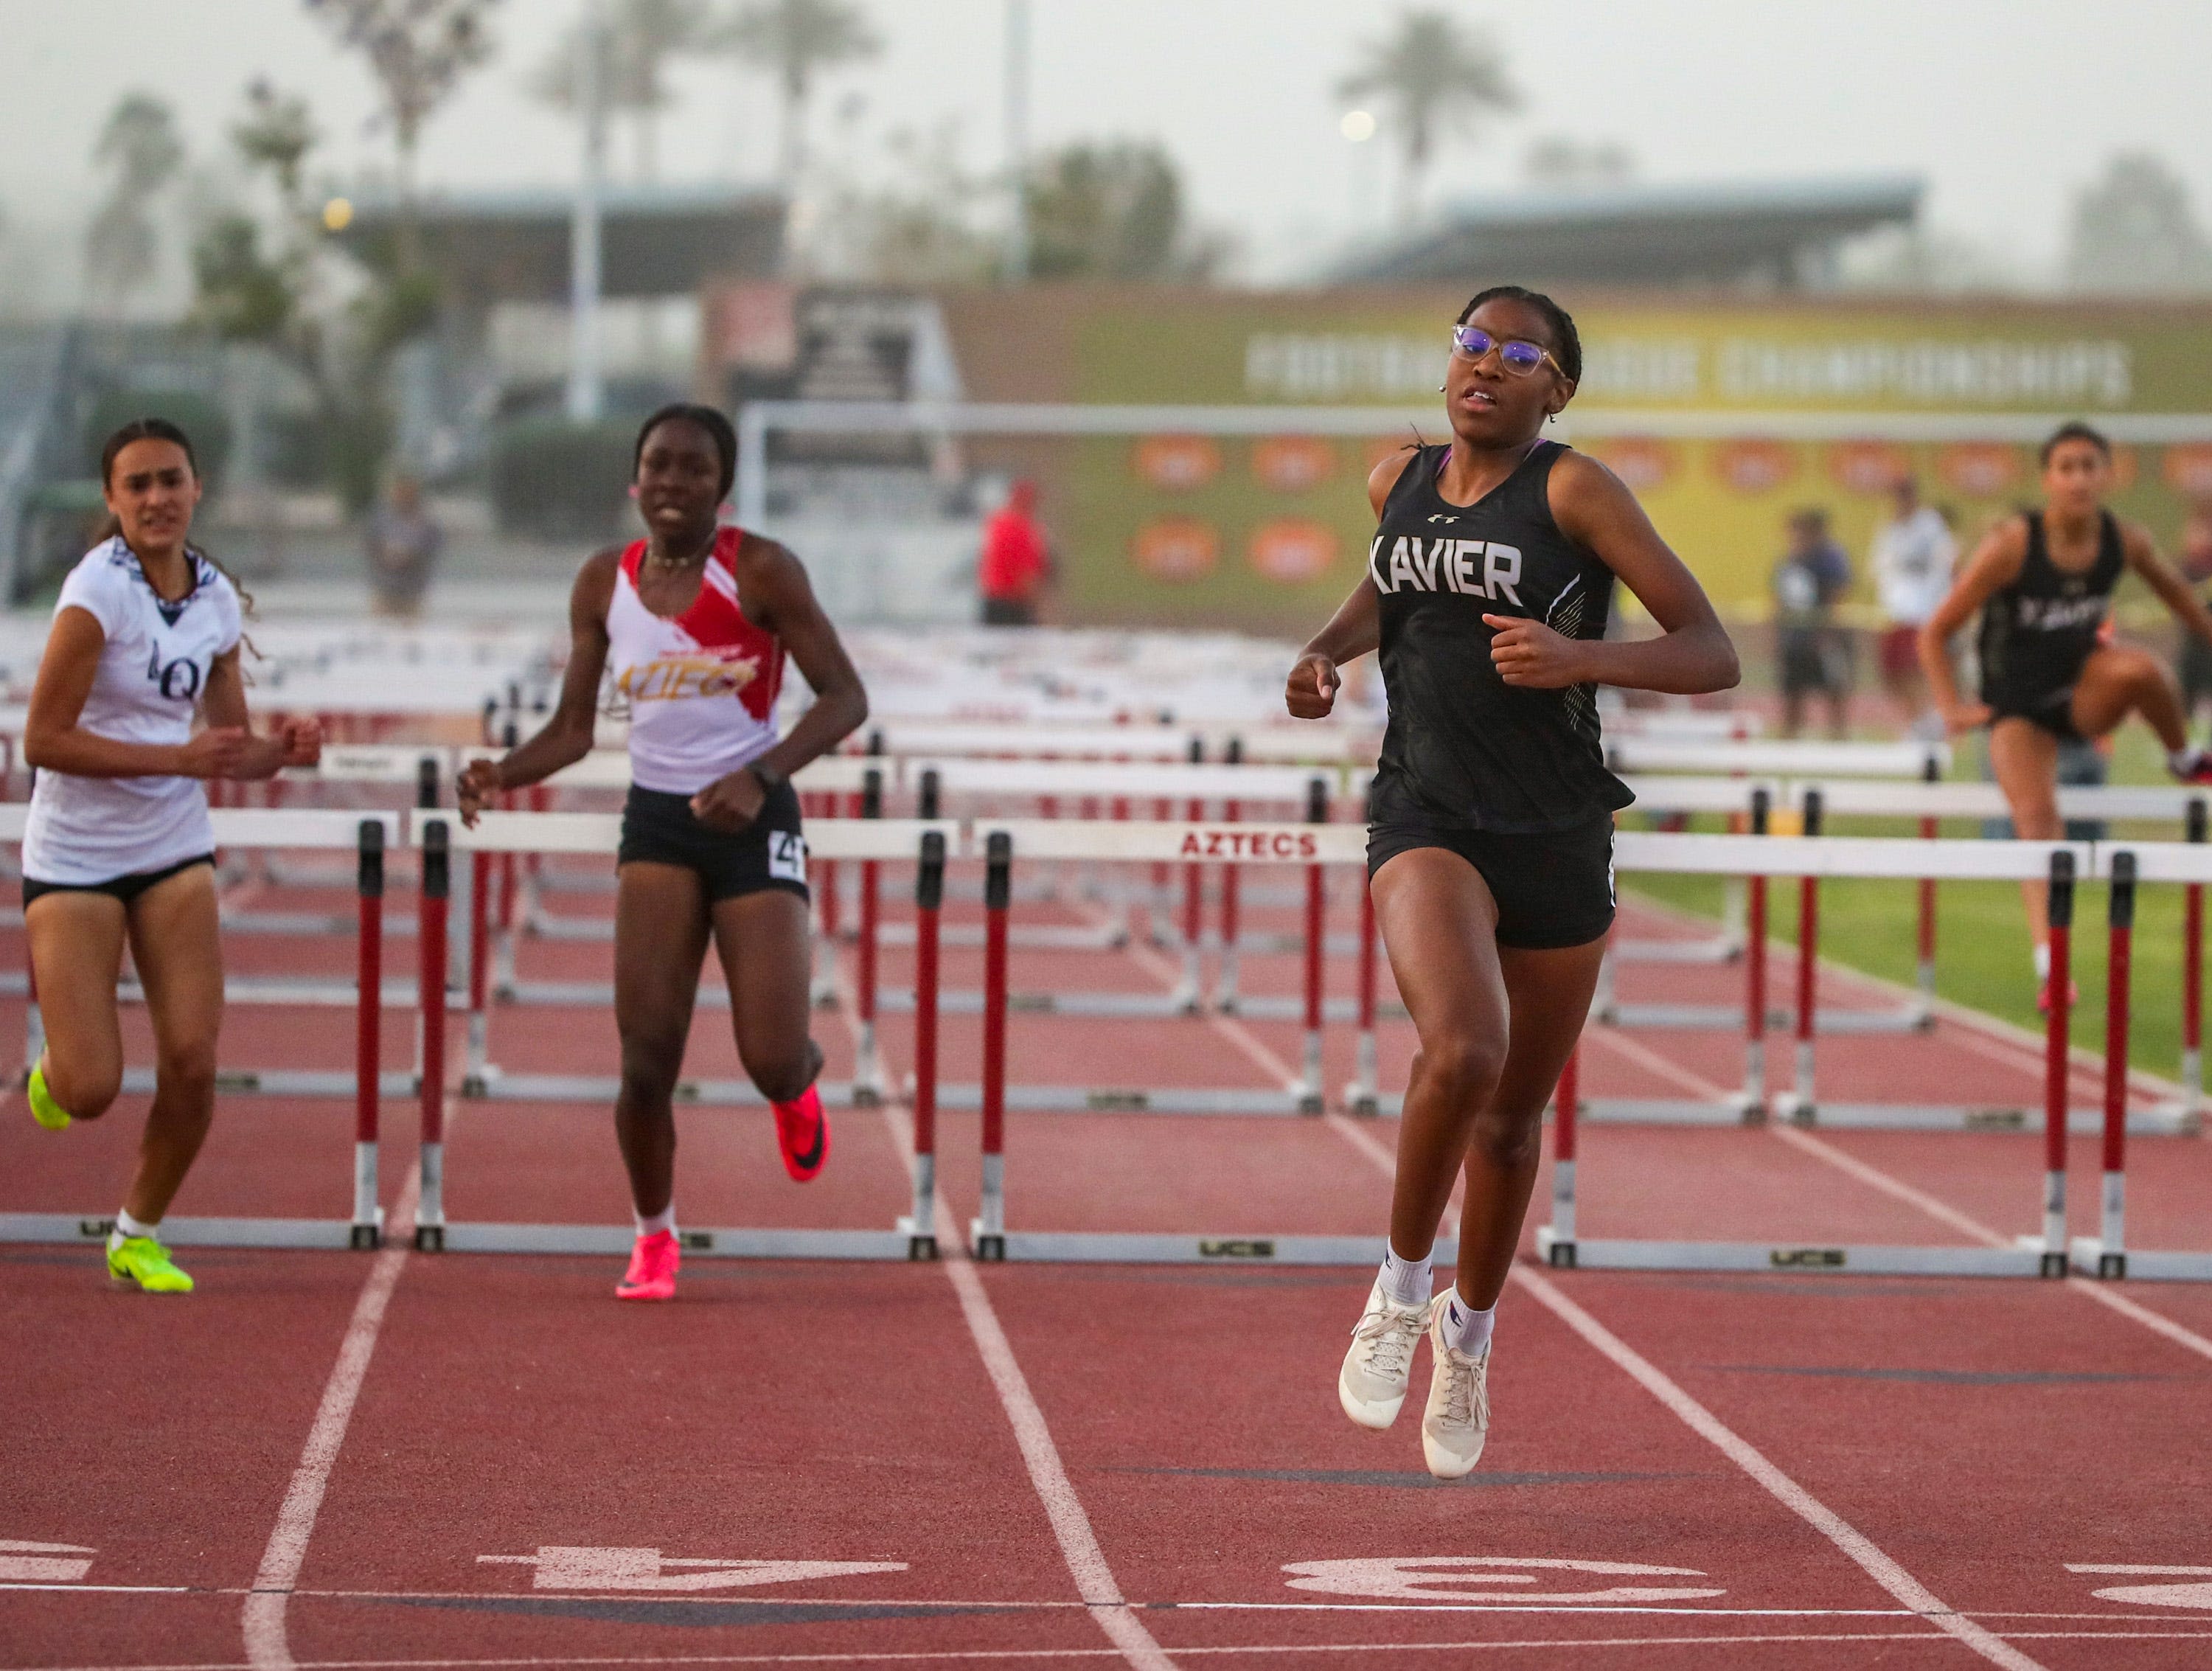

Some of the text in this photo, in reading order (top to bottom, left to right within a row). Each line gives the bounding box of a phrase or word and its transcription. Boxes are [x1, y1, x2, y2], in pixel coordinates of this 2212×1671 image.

[1369, 535, 1523, 607] XAVIER
[776, 835, 798, 873] 4
[1182, 833, 1316, 856] AZTECS
[1199, 1240, 1274, 1257] UCS
[1770, 1250, 1846, 1267] UCS
[476, 1546, 908, 1591] 4
[1280, 1557, 1726, 1602] 3
